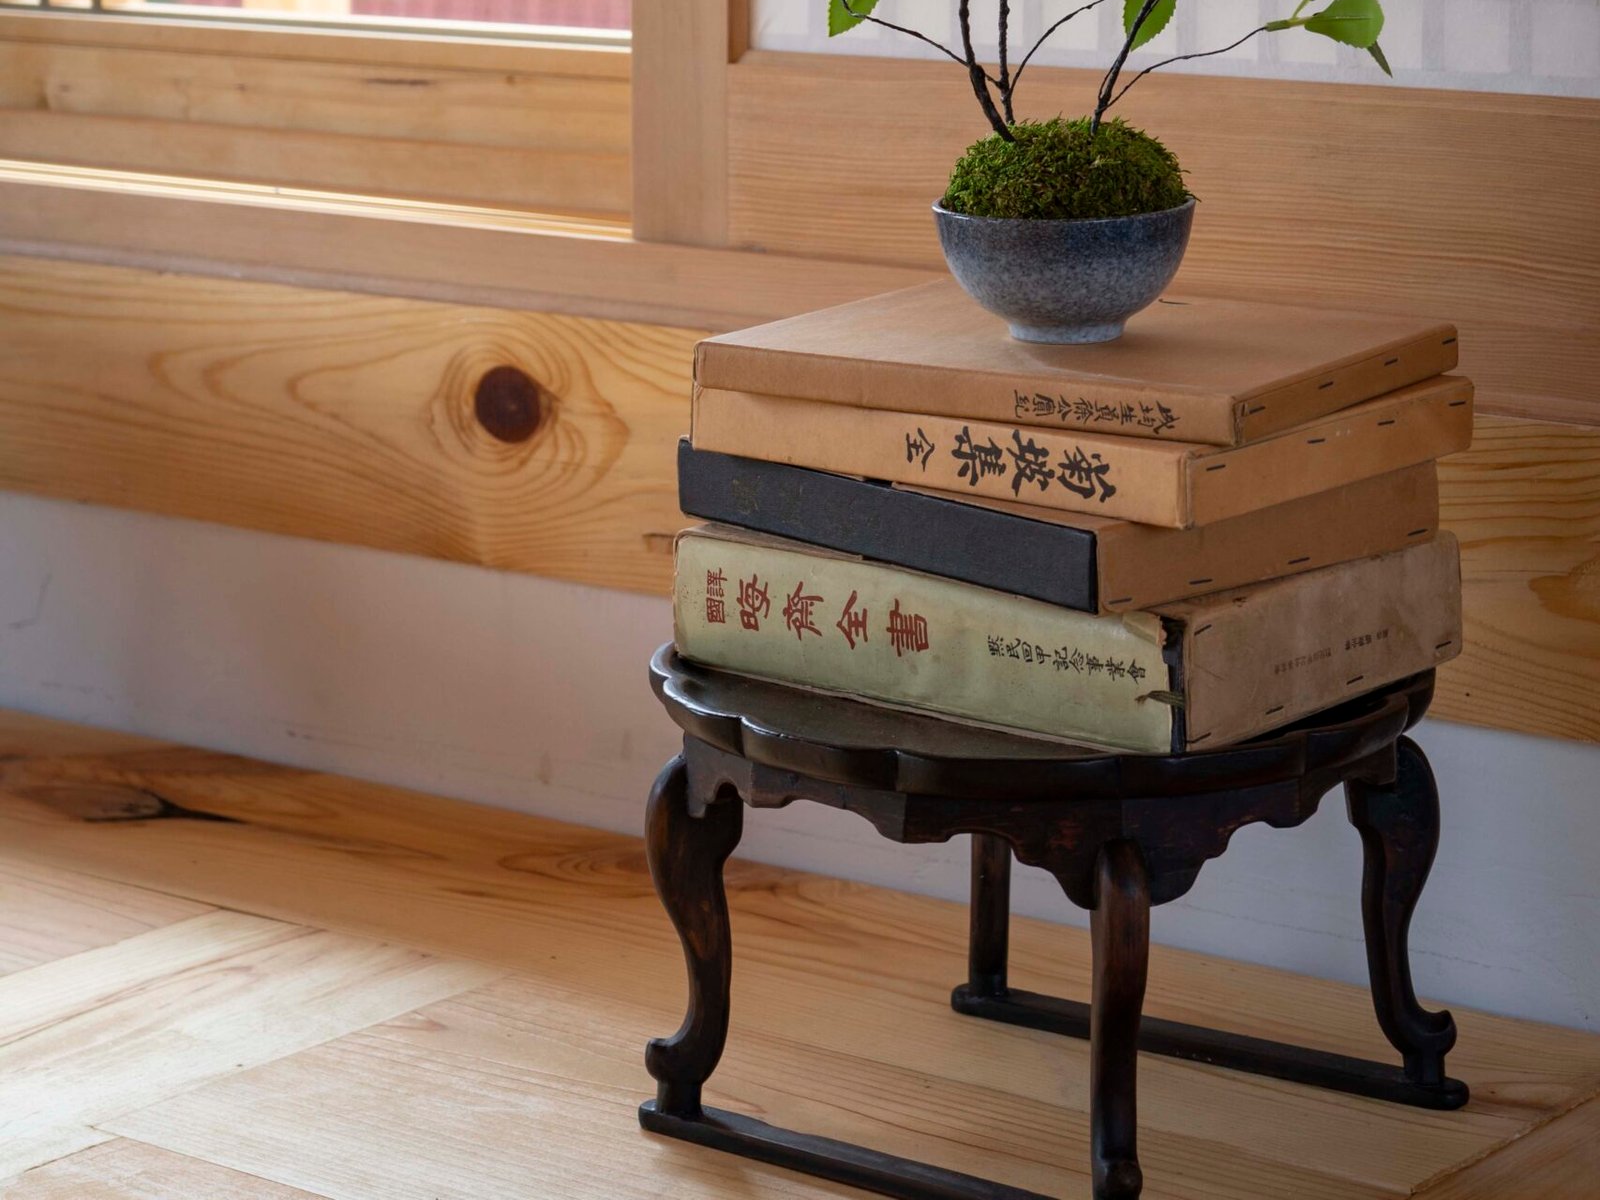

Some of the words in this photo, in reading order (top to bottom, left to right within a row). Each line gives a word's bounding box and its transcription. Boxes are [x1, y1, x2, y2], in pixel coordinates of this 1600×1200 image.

[905, 427, 938, 473] 全
[951, 425, 1118, 504] 菊坡集
[705, 567, 729, 625] 國譯
